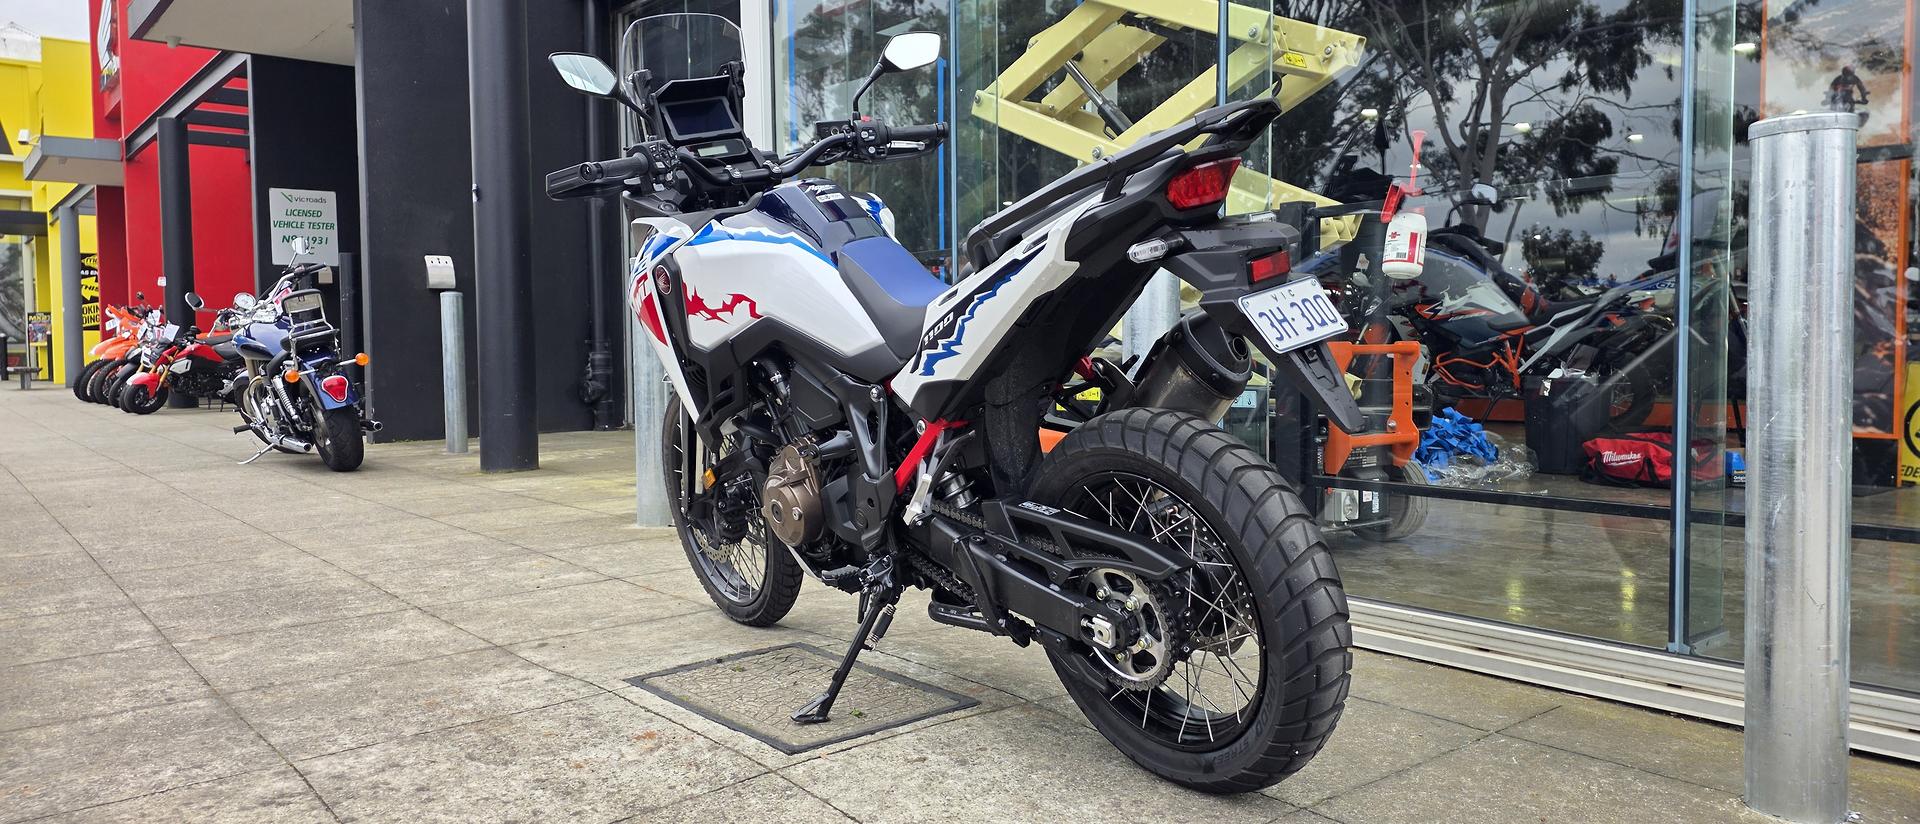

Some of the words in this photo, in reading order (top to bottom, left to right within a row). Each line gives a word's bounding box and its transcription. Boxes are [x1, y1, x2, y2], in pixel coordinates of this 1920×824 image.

[285, 209, 322, 218] LICENSED
[273, 220, 305, 229] VEHICLE
[308, 221, 335, 230] TESTER
[1271, 289, 1295, 303] VIC
[924, 311, 954, 346] 1100
[1602, 450, 1642, 463] Milwaukee
